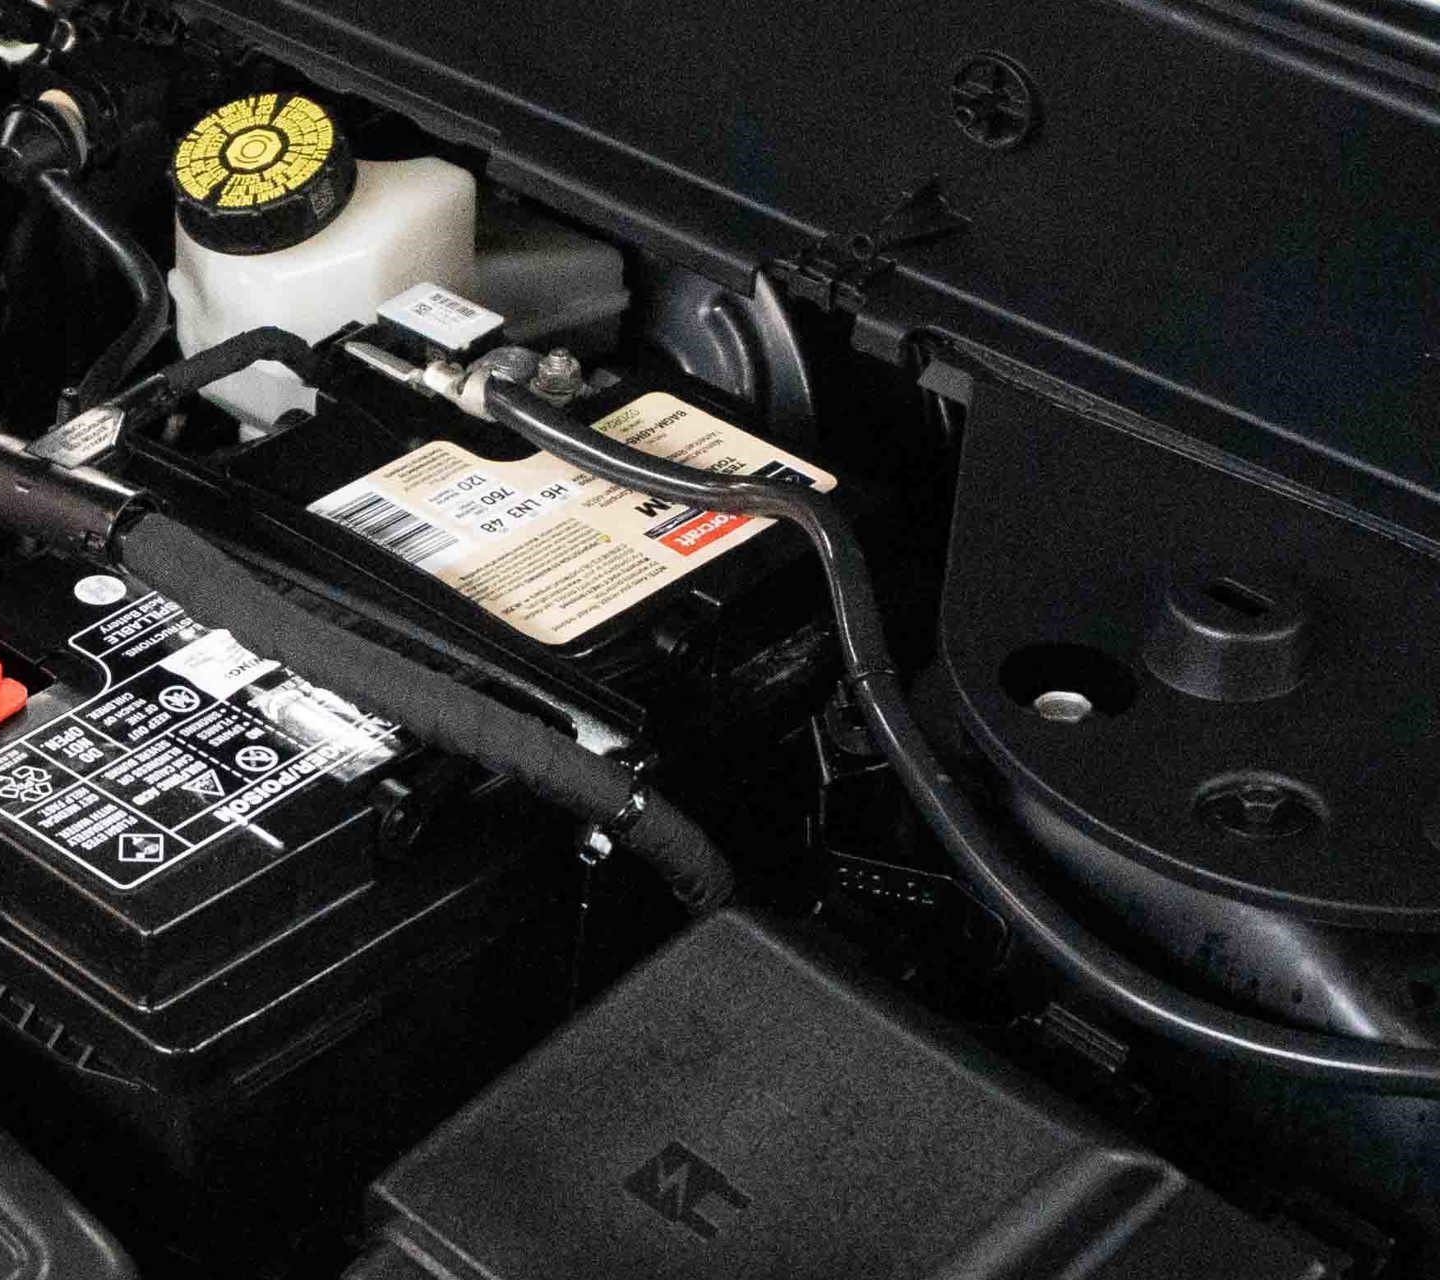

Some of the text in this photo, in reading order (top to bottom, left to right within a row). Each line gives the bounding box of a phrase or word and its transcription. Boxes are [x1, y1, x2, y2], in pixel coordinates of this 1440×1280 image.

[454, 472, 487, 492] 120
[538, 482, 569, 501] H6
[478, 484, 516, 507] 760
[504, 497, 542, 520] LN3
[477, 516, 507, 534] 48
[95, 595, 166, 635] Acid Battery
[123, 702, 160, 725] OF THE
[124, 710, 173, 741] KEEP OUT
[38, 724, 86, 753] OPEN.
[58, 735, 95, 758] NOT
[76, 746, 105, 764] DO
[79, 832, 109, 851] EYES
